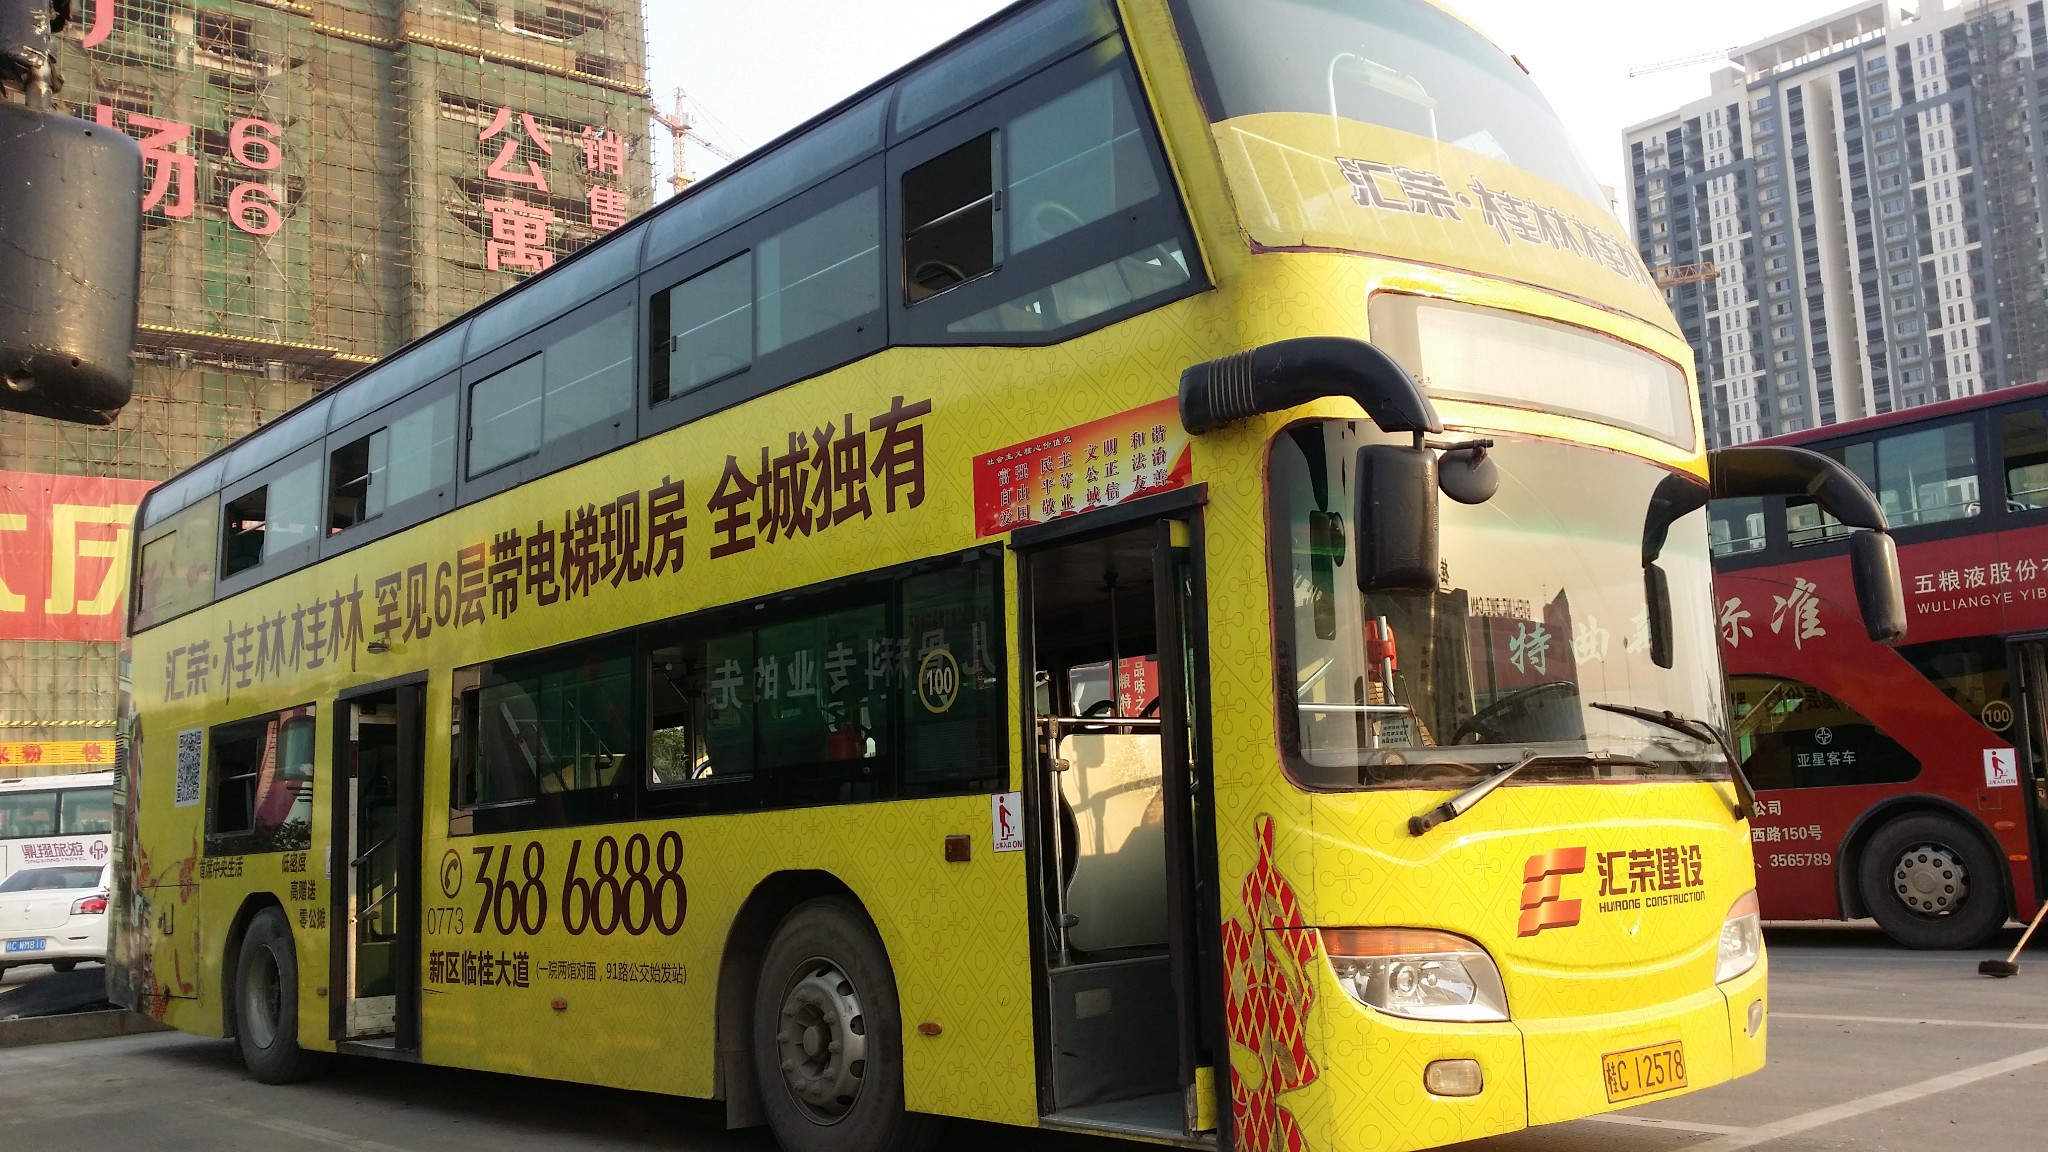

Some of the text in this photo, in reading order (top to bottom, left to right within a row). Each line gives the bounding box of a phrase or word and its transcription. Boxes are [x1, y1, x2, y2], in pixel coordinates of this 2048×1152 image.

[228, 118, 282, 236] 66
[478, 107, 555, 272] 公寓
[581, 126, 628, 231] 销售
[986, 435, 1072, 466] 社会主义核心价值观
[998, 424, 1166, 486] 富强 民主 文明 和谐
[706, 395, 932, 560] 全城独有
[1000, 446, 1167, 506] 自由 平等 公正 法治
[1000, 469, 1168, 527] 爱国 敬业 诚信 友善
[374, 475, 688, 644] 罕见6层带电梯现房
[1917, 592, 2013, 614] WULIANGYE
[164, 574, 364, 706] 汇荣·桂林桂林
[925, 666, 952, 696] 100
[1133, 661, 1146, 717] 品味之
[1985, 709, 2010, 723] 100
[1797, 750, 1857, 768] 亚星客车
[1012, 840, 1023, 848] ON
[1751, 824, 1823, 842] 西路150号
[21, 842, 84, 859] 鼎翔旅游
[282, 852, 307, 874] 低密度
[199, 857, 243, 879] 首席中央生活
[472, 830, 687, 936] 368 6888
[1597, 844, 1704, 897] 汇荣建设
[290, 880, 316, 901] 高赠送
[1599, 890, 1706, 913] HUIRONG CONSTRUCTION
[299, 908, 326, 929] 零公摊
[427, 907, 464, 935] 0773
[429, 950, 530, 988] 新区临桂大道
